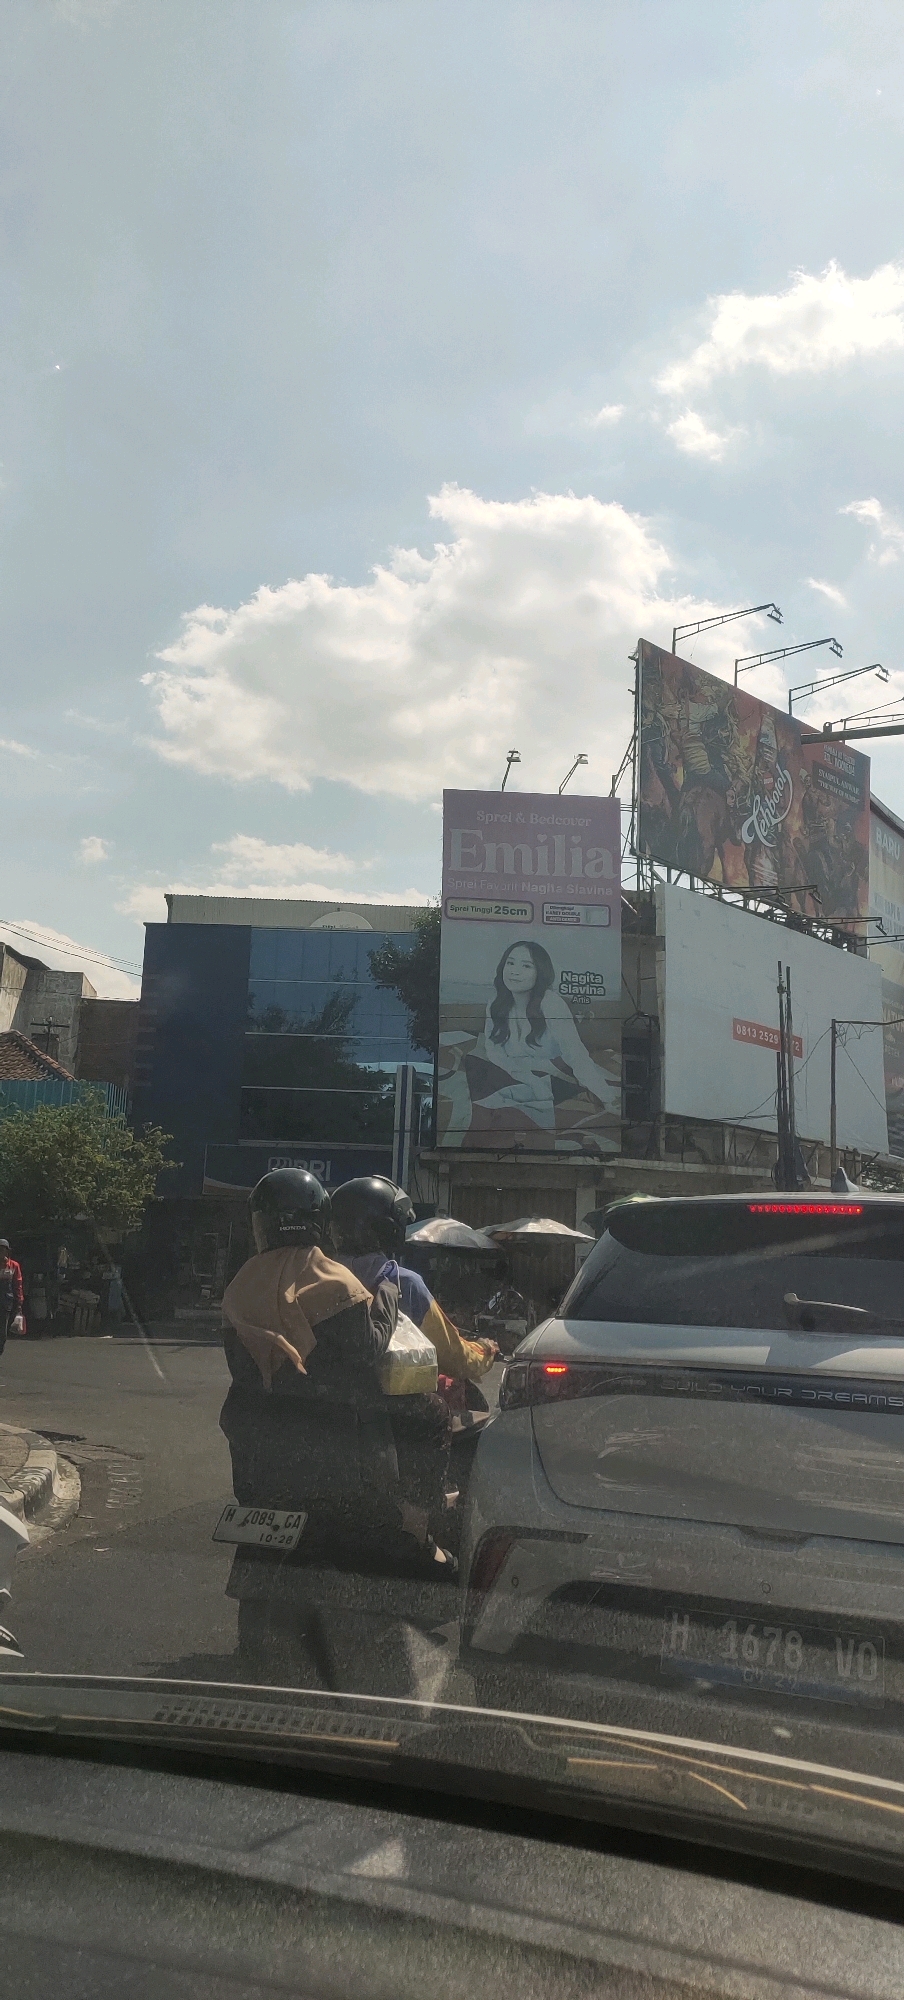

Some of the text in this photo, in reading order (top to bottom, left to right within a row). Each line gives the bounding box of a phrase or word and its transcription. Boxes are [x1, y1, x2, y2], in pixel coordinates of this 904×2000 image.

[476, 810, 592, 827] Sprei & Bedcover
[876, 828, 901, 860] BARU
[448, 828, 618, 880] Emilia
[447, 877, 613, 896] Sprei Favorit Nagita Slavina
[450, 904, 528, 916] Sprei Tinggi 25cm
[561, 971, 604, 984] Nagita
[559, 983, 606, 996] Slavina
[571, 996, 590, 1004] Artis
[736, 1025, 779, 1044] 0813 2529
[661, 1378, 904, 1407] BUILD YOUR DREAMS
[225, 1508, 237, 1523] H
[670, 1612, 690, 1653] H
[721, 1619, 804, 1670] 1678
